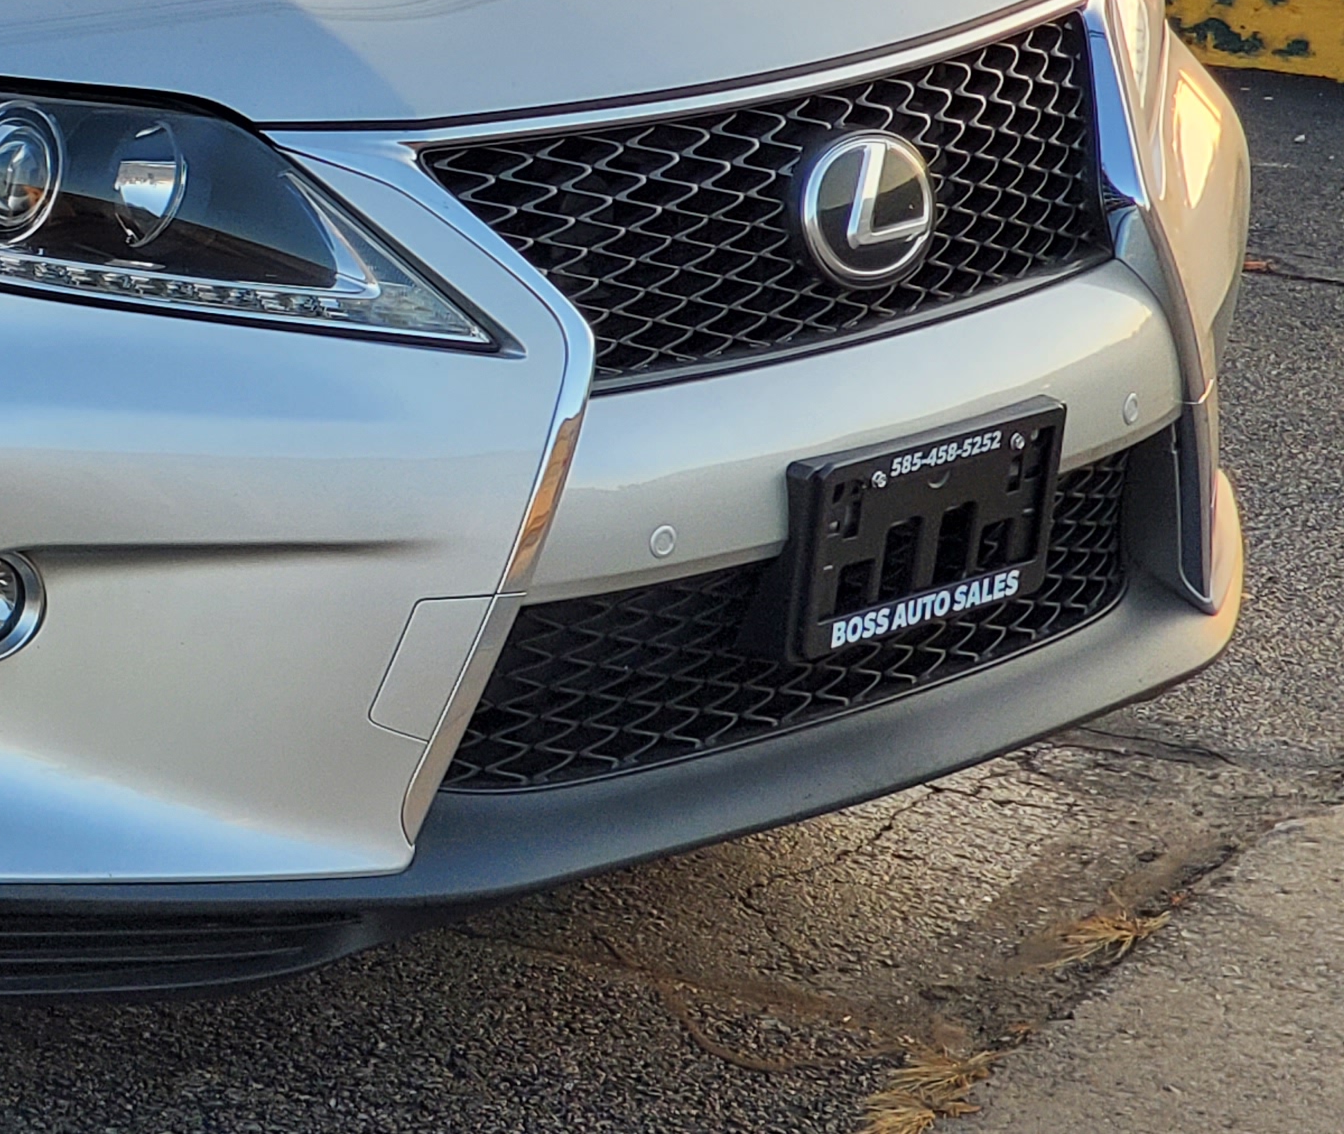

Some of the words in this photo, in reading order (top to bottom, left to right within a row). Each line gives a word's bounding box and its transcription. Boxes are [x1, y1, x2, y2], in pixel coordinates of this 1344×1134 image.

[890, 430, 1003, 478] 585-458-5252
[831, 608, 893, 649] BOSS
[891, 590, 951, 632] AUTO
[952, 570, 1020, 612] SALES
